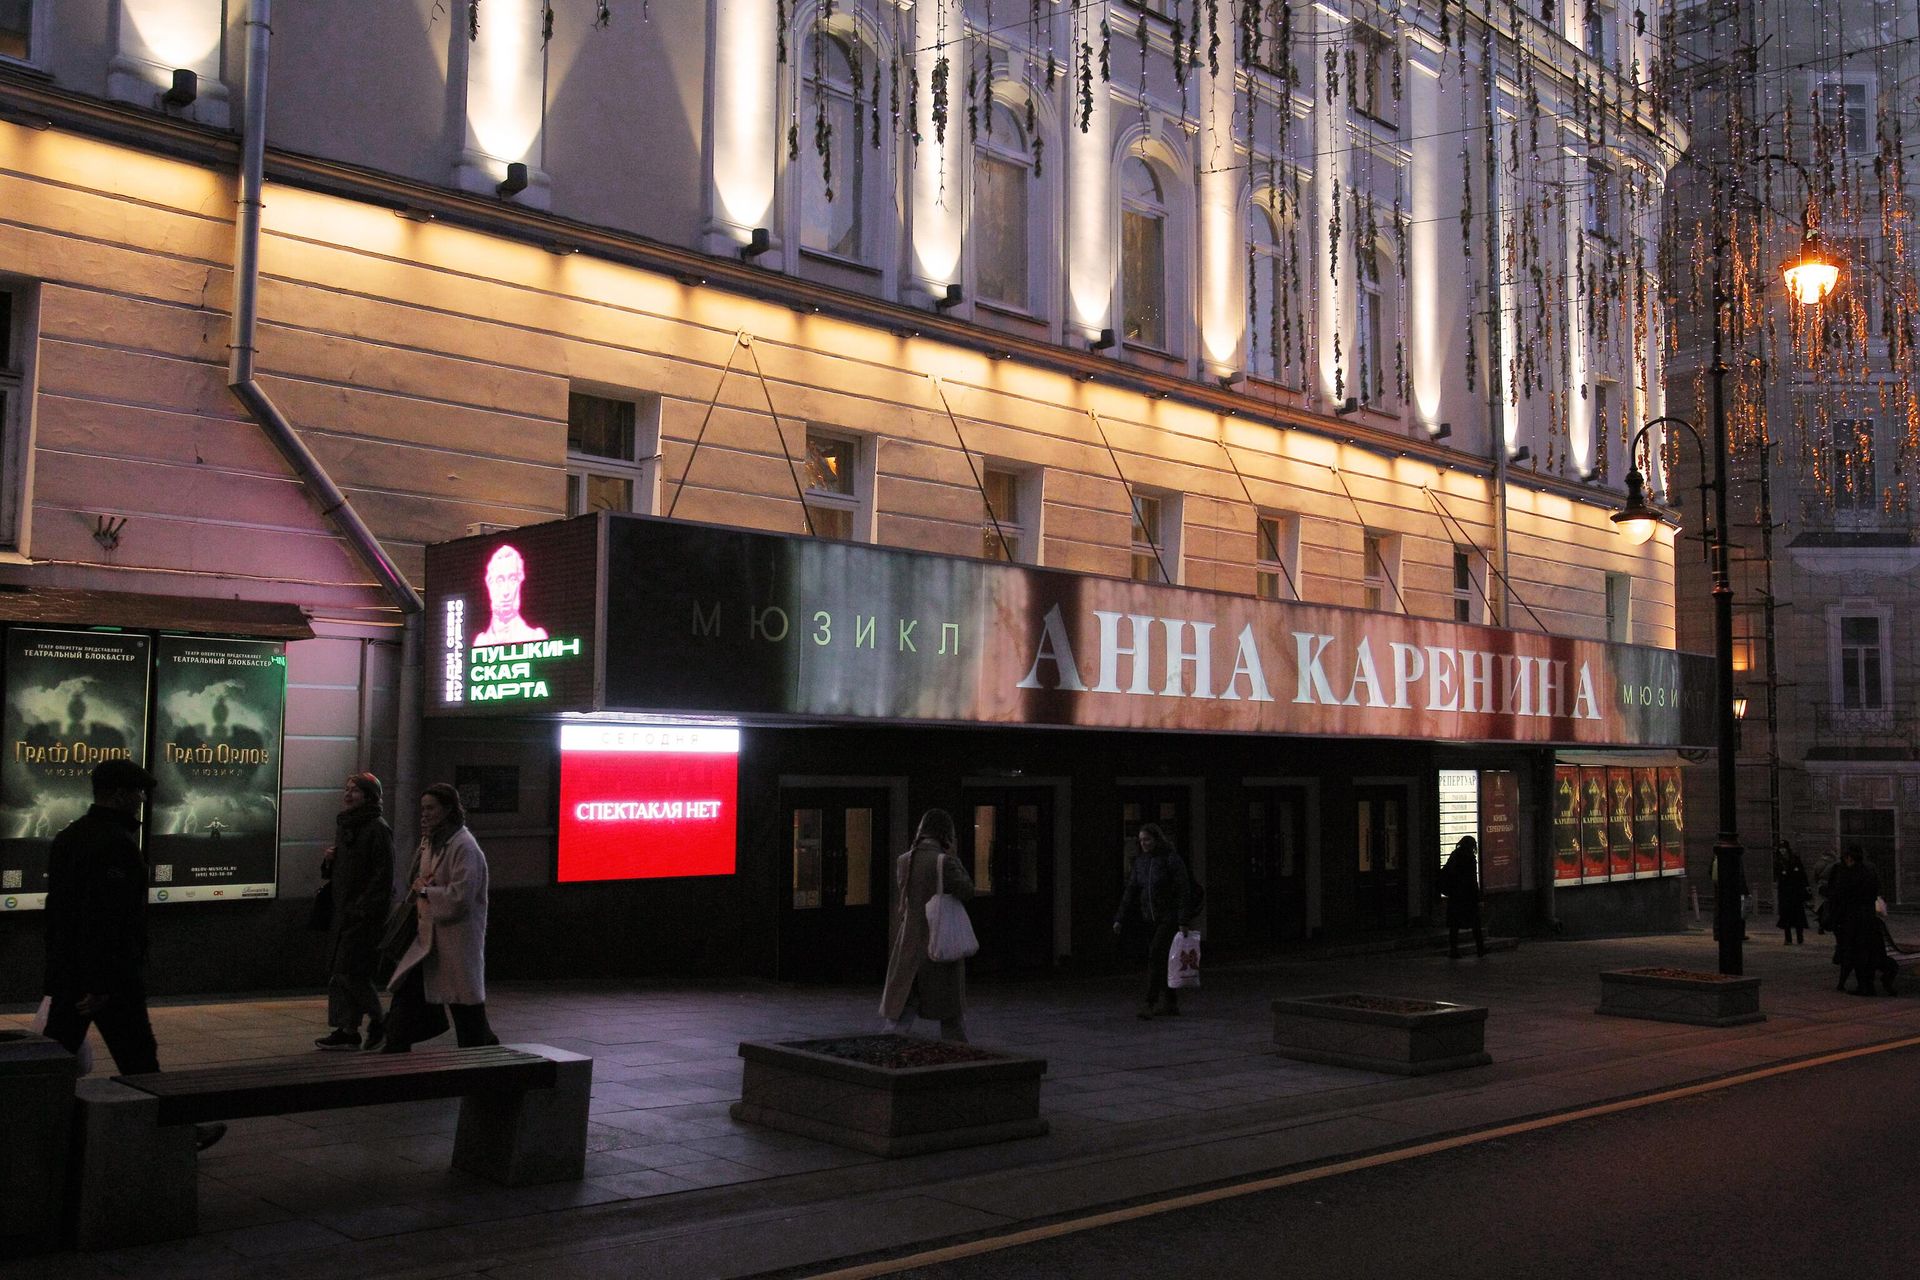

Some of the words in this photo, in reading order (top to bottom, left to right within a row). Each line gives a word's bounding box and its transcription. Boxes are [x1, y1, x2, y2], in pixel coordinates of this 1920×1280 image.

[24, 649, 82, 659] ТЕАТРАЛЬНЫЙ
[85, 652, 135, 662] БЛОКБАСТЕР
[471, 638, 579, 663] ПУШКИН
[173, 656, 225, 665] ТЕАТРАЛЬНЫЙ
[227, 659, 272, 667] БЛОКБАСТЕР
[691, 598, 960, 656] МЮЗИКЛ
[1015, 602, 1276, 702] АННА
[1291, 631, 1603, 720] КАРЕНИНА
[470, 662, 530, 682] СКАЯ
[470, 681, 549, 701] КАРТА
[601, 732, 699, 746] СЕГОДНЯ
[44, 768, 94, 777] МЮЗИК
[192, 768, 243, 777] МЮЗИКЛ
[1439, 775, 1477, 787] РЕПЕРТУАР
[575, 801, 683, 820] СПЕКТАКЛЯ
[686, 801, 721, 818] НЕТ
